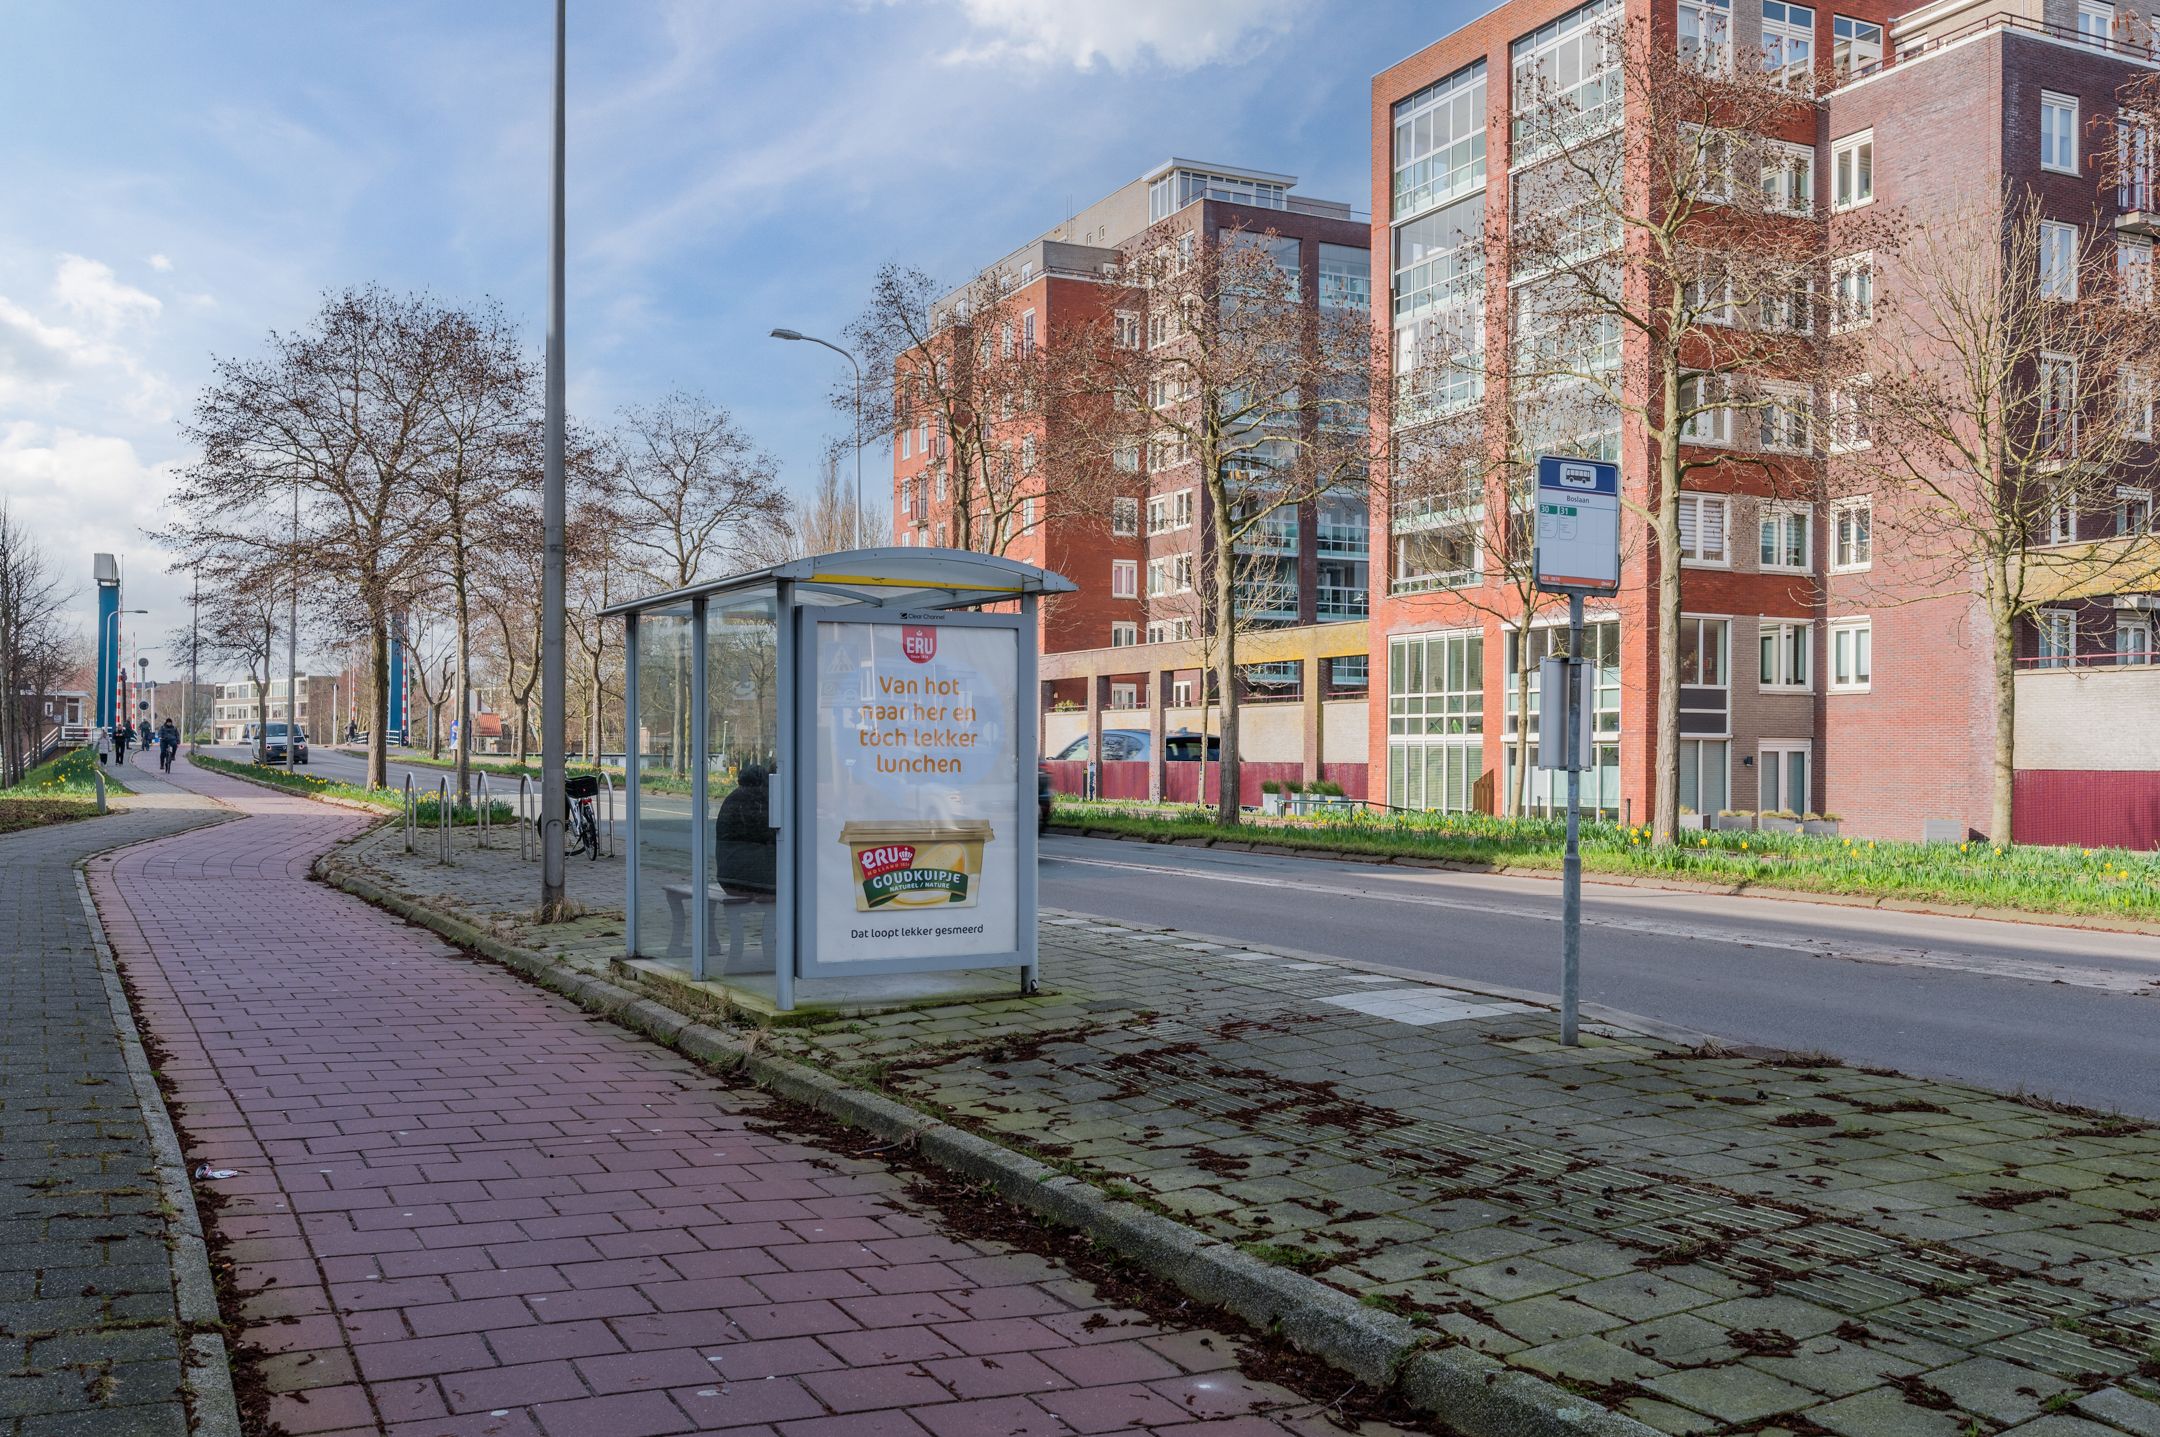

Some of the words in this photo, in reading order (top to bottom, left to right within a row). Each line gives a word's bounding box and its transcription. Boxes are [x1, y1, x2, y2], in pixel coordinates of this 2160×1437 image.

[1566, 495, 1590, 504] Boslaan
[1541, 505, 1550, 513] 30
[1560, 507, 1569, 515] 31
[906, 637, 933, 655] ERU
[879, 676, 918, 694] Van
[925, 676, 960, 695] hot
[862, 705, 907, 721] naar
[913, 703, 947, 721] her
[952, 705, 977, 721] en
[859, 728, 907, 747] toch
[914, 728, 978, 747] lekker
[877, 754, 962, 773] lunchen
[872, 870, 960, 889] GOUDKUIPJE
[889, 883, 918, 893] NATUREL
[851, 929, 869, 939] Dat
[871, 928, 899, 939] loopt
[901, 926, 933, 937] lekker
[935, 924, 984, 937] gesmeerd
